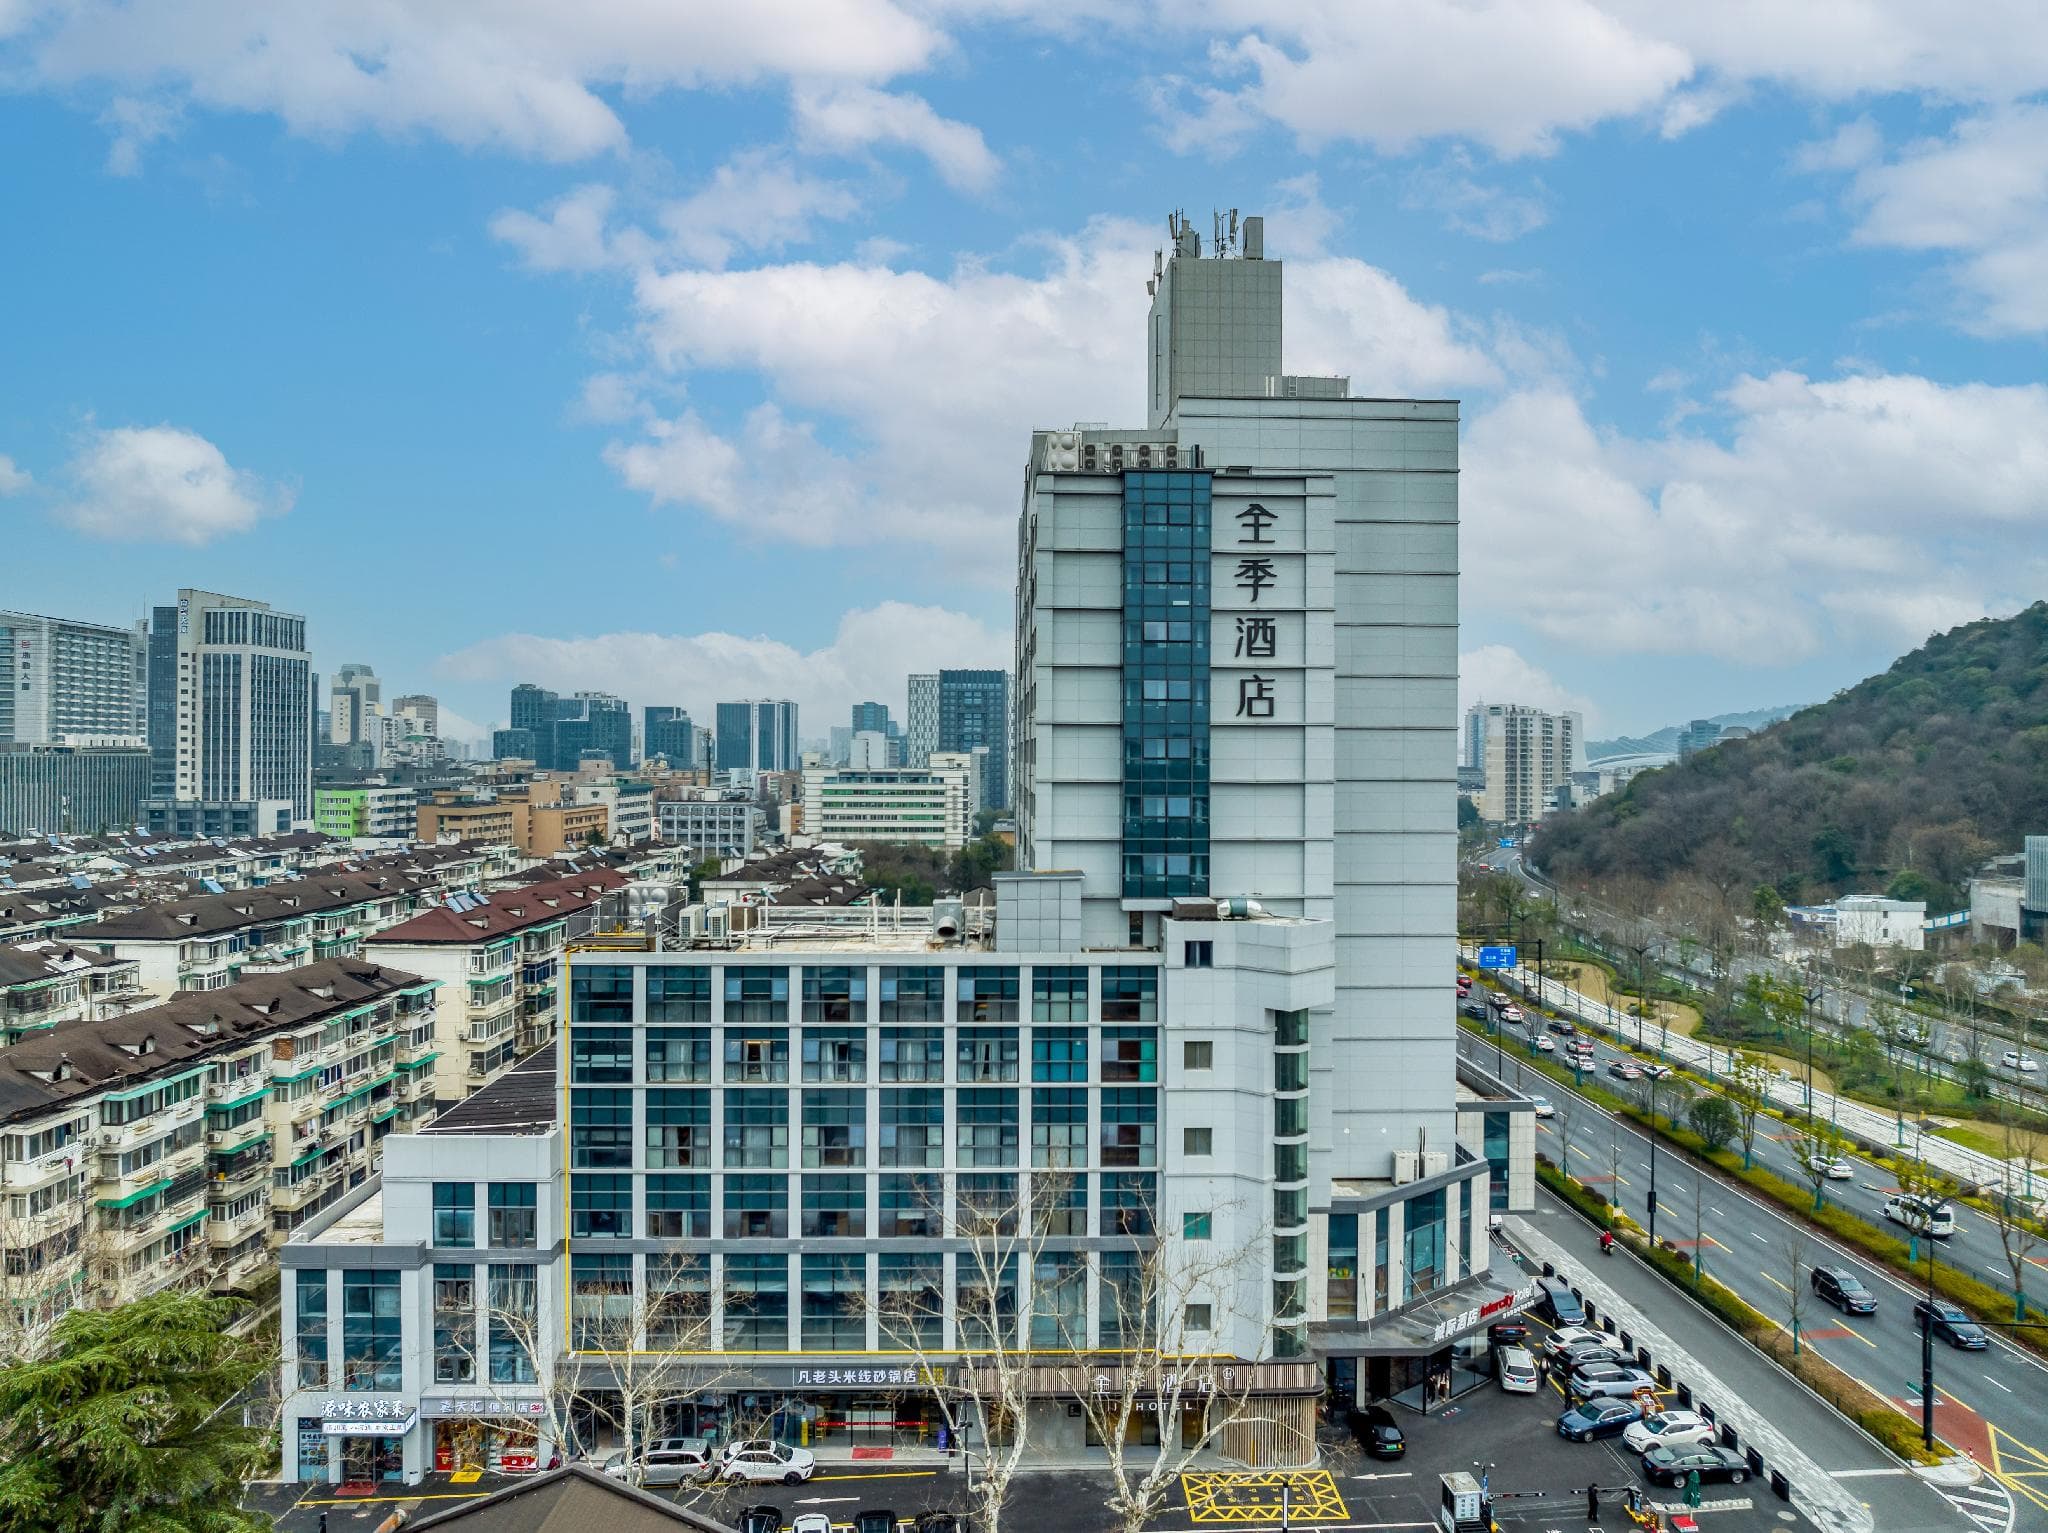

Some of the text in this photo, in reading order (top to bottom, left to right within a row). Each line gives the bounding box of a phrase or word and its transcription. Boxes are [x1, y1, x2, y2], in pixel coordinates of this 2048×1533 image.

[1234, 503, 1279, 717] 全季酒店
[320, 1399, 404, 1418] 源味农家菜
